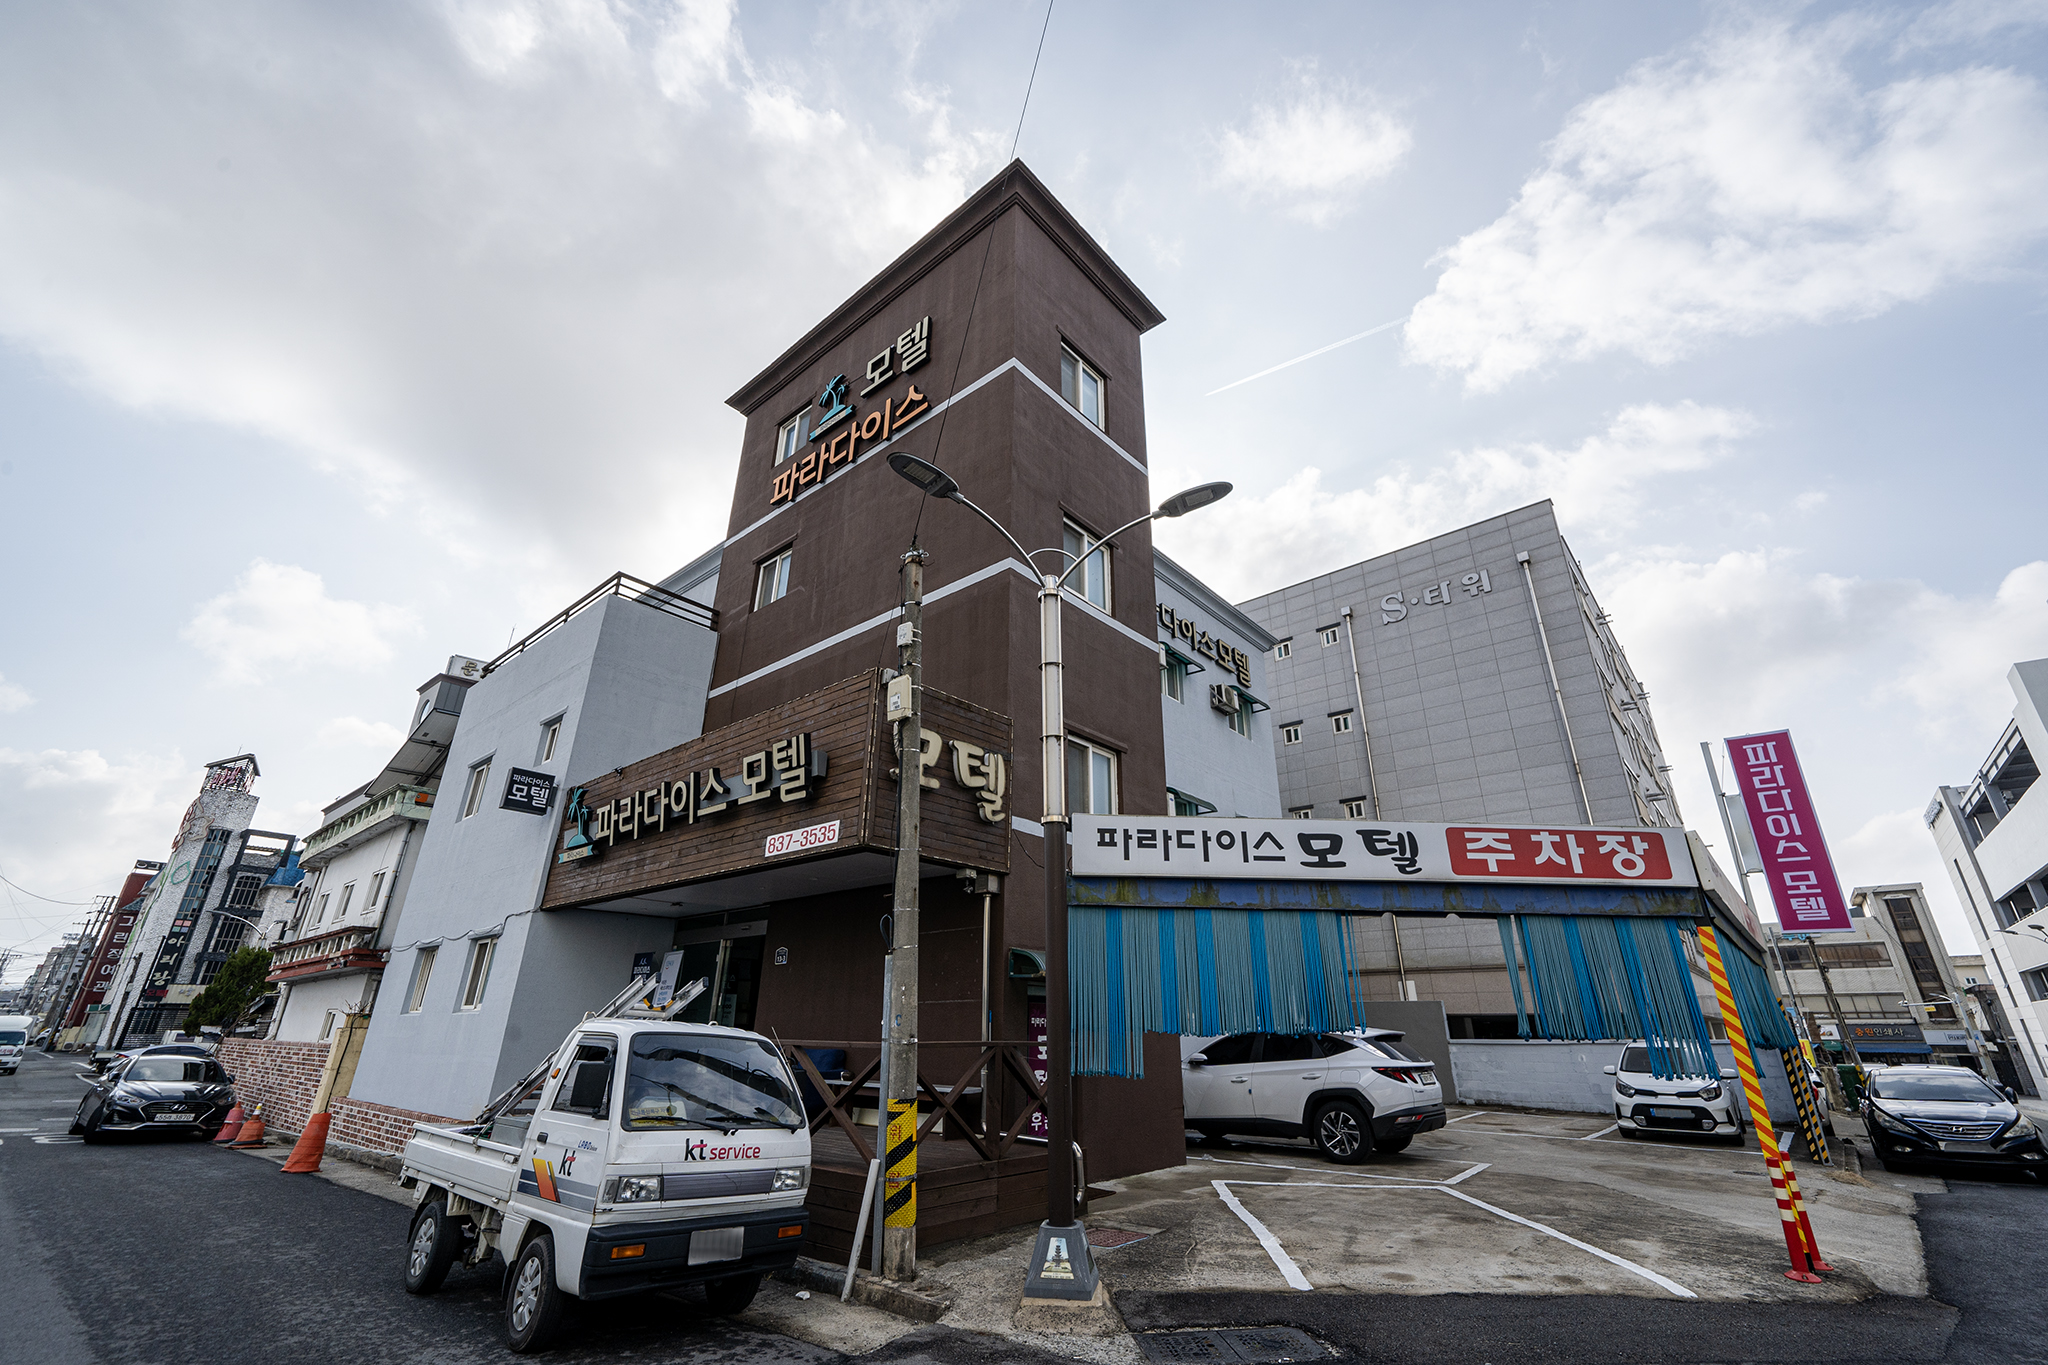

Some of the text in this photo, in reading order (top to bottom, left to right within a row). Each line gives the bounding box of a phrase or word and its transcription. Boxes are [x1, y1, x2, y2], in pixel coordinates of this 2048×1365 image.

[860, 315, 931, 397] 모텔
[770, 385, 930, 505] 파라다이스
[1157, 603, 1252, 688] 다이스모텔
[508, 783, 550, 809] 모텔
[512, 774, 551, 788] 파라다이스
[596, 732, 808, 847] 파라다이스 모텔
[767, 823, 837, 854] 837-3535
[1097, 827, 1650, 877] 파라다이스 모텔 주차장
[1743, 741, 1811, 862] 파라다이스
[1782, 870, 1831, 922] 모텔
[153, 935, 186, 986] 아리랑
[558, 1148, 576, 1176] kt
[684, 1138, 761, 1161] kt service
